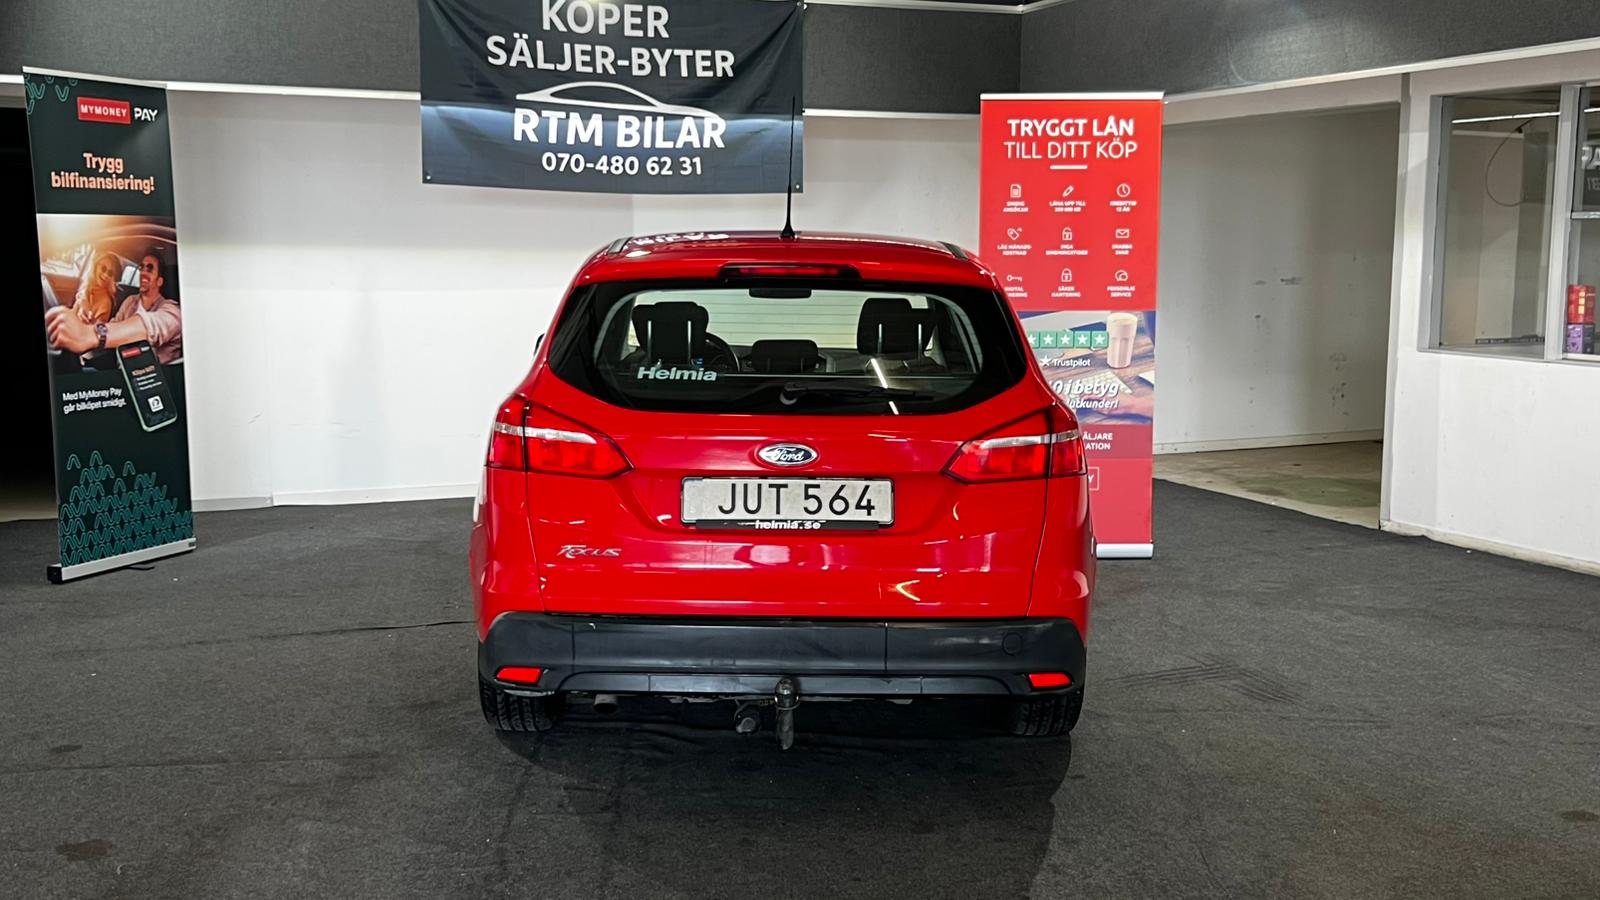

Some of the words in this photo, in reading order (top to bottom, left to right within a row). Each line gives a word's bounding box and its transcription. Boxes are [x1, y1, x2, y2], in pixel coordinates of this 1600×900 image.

[486, 33, 735, 77] SÄLJER-BYTER
[80, 104, 127, 117] MYMONEY
[134, 108, 158, 121] PAY
[513, 108, 603, 147] RTM
[616, 115, 726, 149] BILAR
[1007, 119, 1088, 137] TRYGGT
[1092, 115, 1134, 137] LÅN
[1003, 141, 1042, 159] TILL
[1047, 141, 1091, 159] DITT
[1096, 137, 1137, 159] KÖP
[83, 152, 124, 174] Trygg
[541, 152, 639, 176] 070-480
[646, 156, 673, 176] 62
[679, 156, 702, 176] 31
[51, 171, 155, 195] bilfinansiering!
[637, 367, 717, 381] Helmia
[1053, 358, 1091, 368] Trustpilot
[1074, 380, 1120, 398] betyg
[770, 446, 805, 462] Ford
[718, 483, 788, 515] JUT
[803, 484, 875, 516] 564
[755, 520, 821, 530] helmia.se
